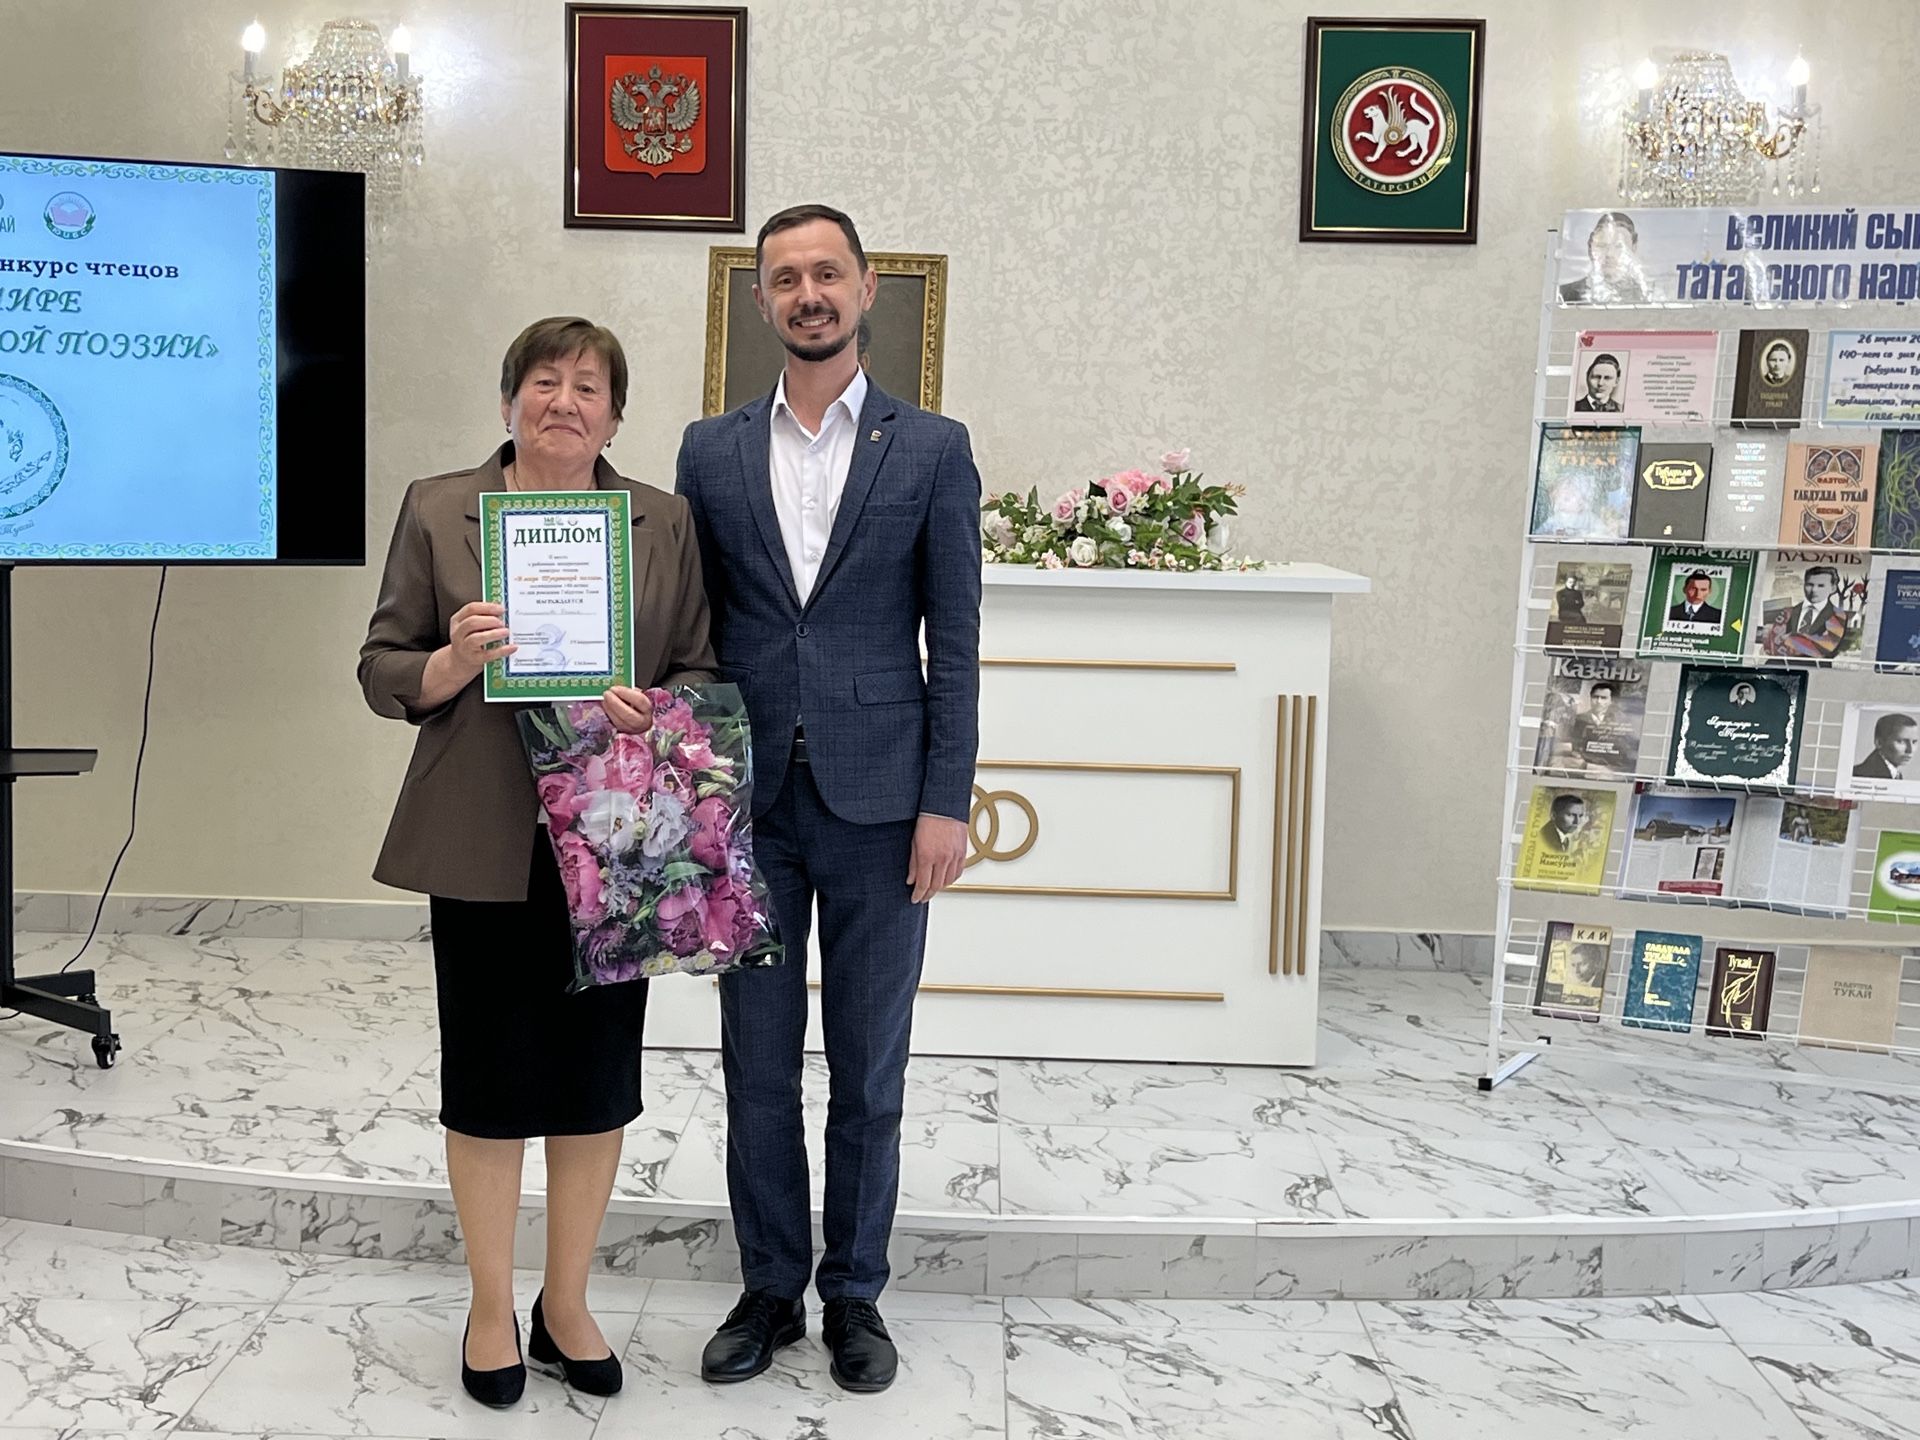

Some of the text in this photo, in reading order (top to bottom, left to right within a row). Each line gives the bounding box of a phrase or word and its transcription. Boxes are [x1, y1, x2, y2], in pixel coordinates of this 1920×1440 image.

[1358, 174, 1427, 192] ТАТАРСТАН
[0, 259, 179, 279] нкурс чтецов
[55, 329, 219, 359] ПОЭЗИИ»
[1857, 333, 1873, 344] 26
[1874, 336, 1907, 345] апреля
[1896, 352, 1915, 360] дня
[1793, 488, 1868, 502] ГАБДУЛЛА ТУКАЙ
[513, 527, 602, 547] ДИПЛОМ
[1660, 546, 1751, 560] ТАТАРСТАН
[1553, 657, 1642, 683] Казань
[1727, 954, 1753, 971] Тукай
[1833, 986, 1873, 999] ТУКАЙ
